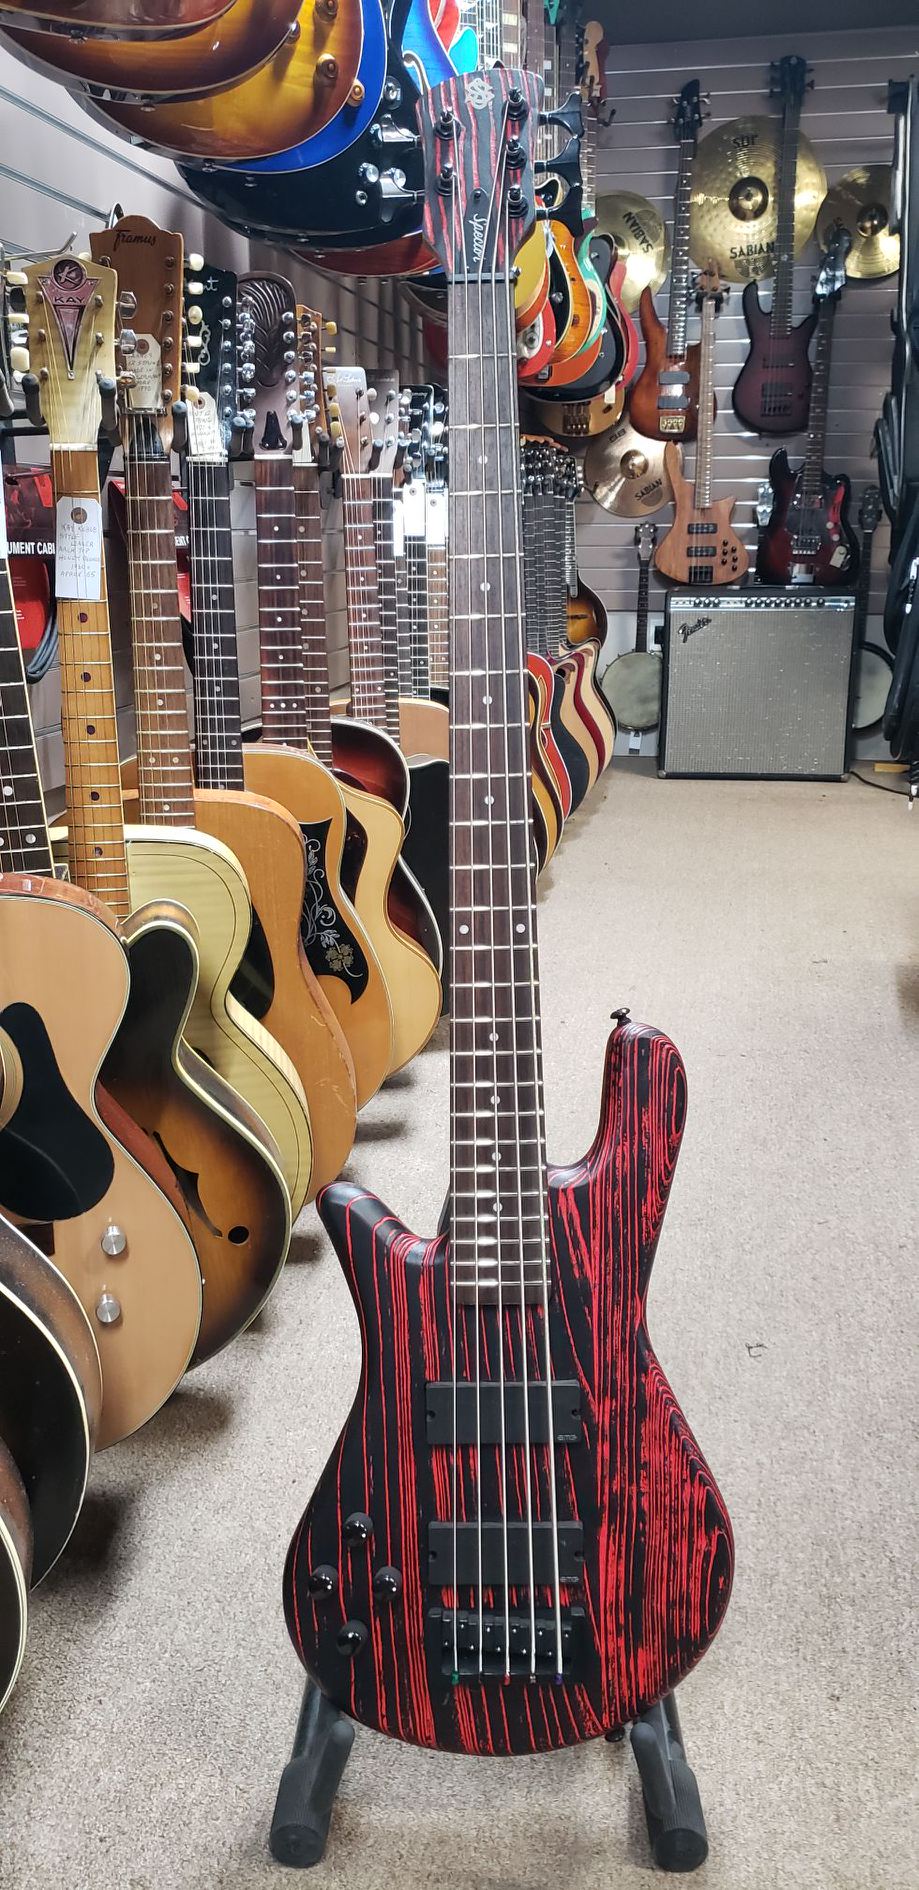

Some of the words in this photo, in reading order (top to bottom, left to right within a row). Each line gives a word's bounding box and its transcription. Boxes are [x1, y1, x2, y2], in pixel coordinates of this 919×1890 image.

[113, 229, 157, 251] Framus
[468, 213, 488, 263] Spector
[622, 211, 654, 253] SABIAN
[729, 242, 775, 260] SABIAN
[54, 296, 85, 304] KAY
[635, 478, 662, 501] SABIAN
